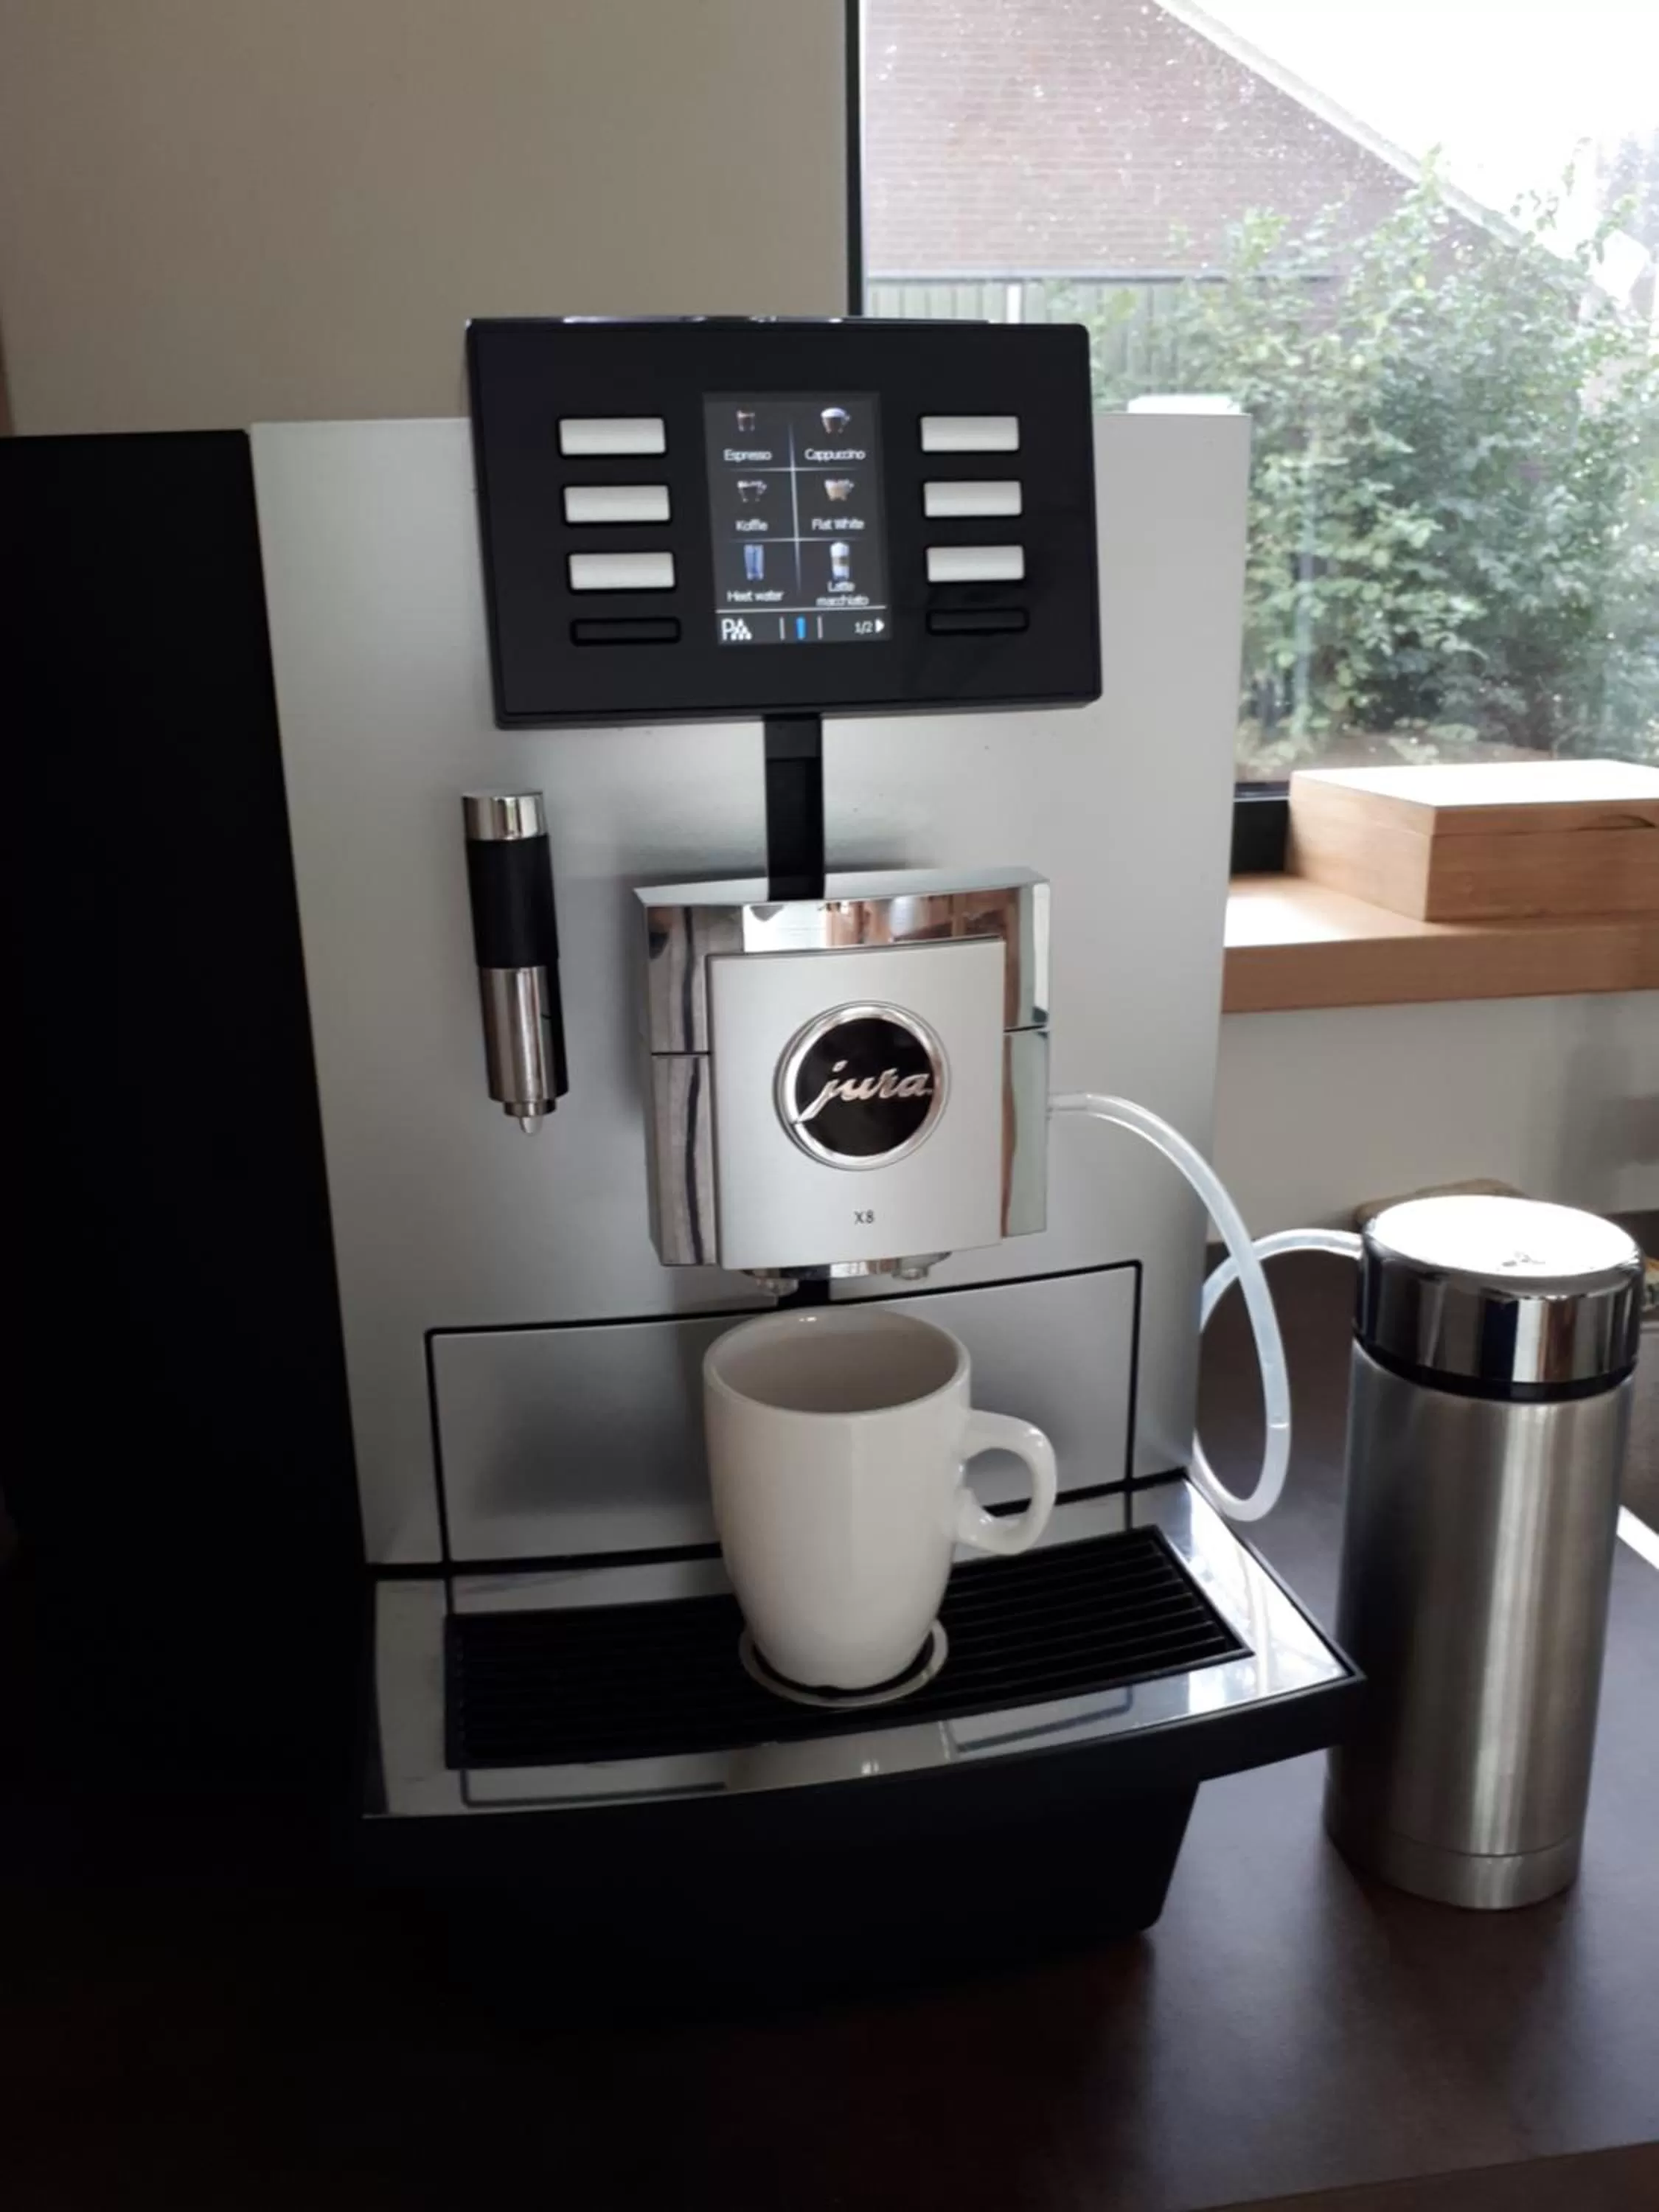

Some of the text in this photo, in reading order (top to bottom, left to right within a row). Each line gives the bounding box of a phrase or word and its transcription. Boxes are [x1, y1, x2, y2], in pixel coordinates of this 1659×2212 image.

[723, 448, 772, 462] Espresso
[804, 448, 866, 462] Cappuccino
[735, 518, 768, 532] Koffie
[812, 518, 865, 530] Flat White
[793, 1060, 933, 1124] jura
[854, 1210, 874, 1225] X8
